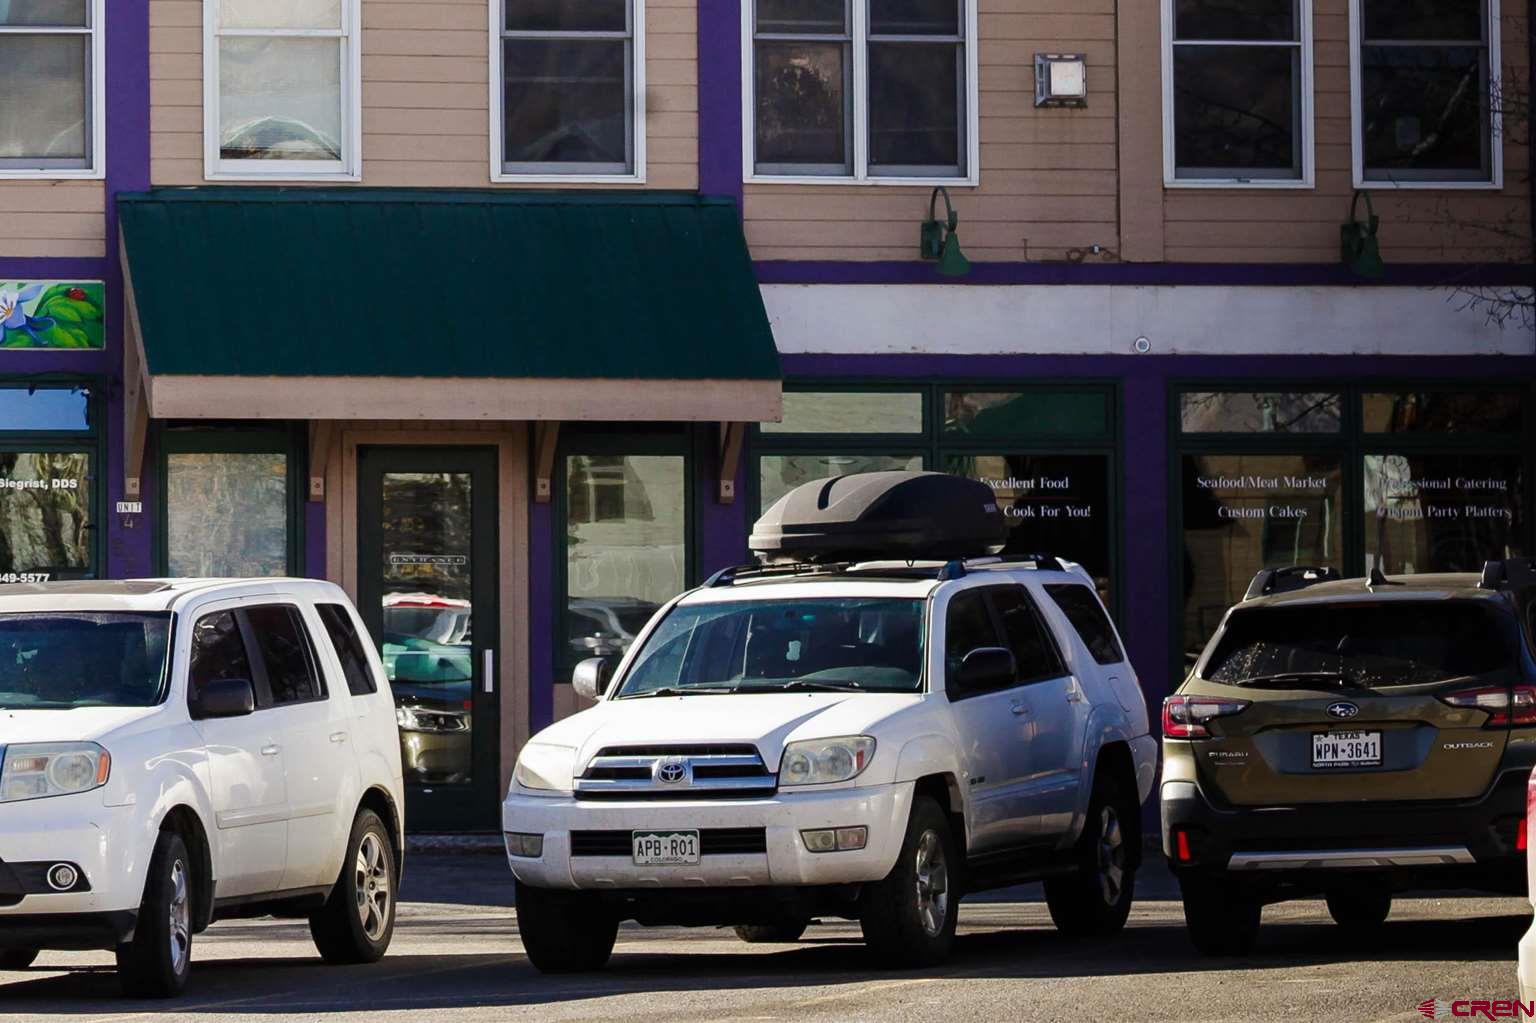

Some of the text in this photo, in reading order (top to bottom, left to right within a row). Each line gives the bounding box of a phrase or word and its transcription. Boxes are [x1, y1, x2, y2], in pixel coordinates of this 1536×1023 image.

[52, 478, 78, 489] DDS
[1040, 476, 1069, 489] Food
[1197, 476, 1327, 489] Seafood/Meat Market
[1455, 477, 1507, 490] Catering
[118, 503, 141, 512] UNIT
[1004, 505, 1035, 517] Cook
[1041, 505, 1060, 517] For
[1066, 505, 1091, 517] You!
[1217, 505, 1308, 518] Custom Cakes
[1427, 505, 1458, 520] Party
[1465, 505, 1512, 518] Platters
